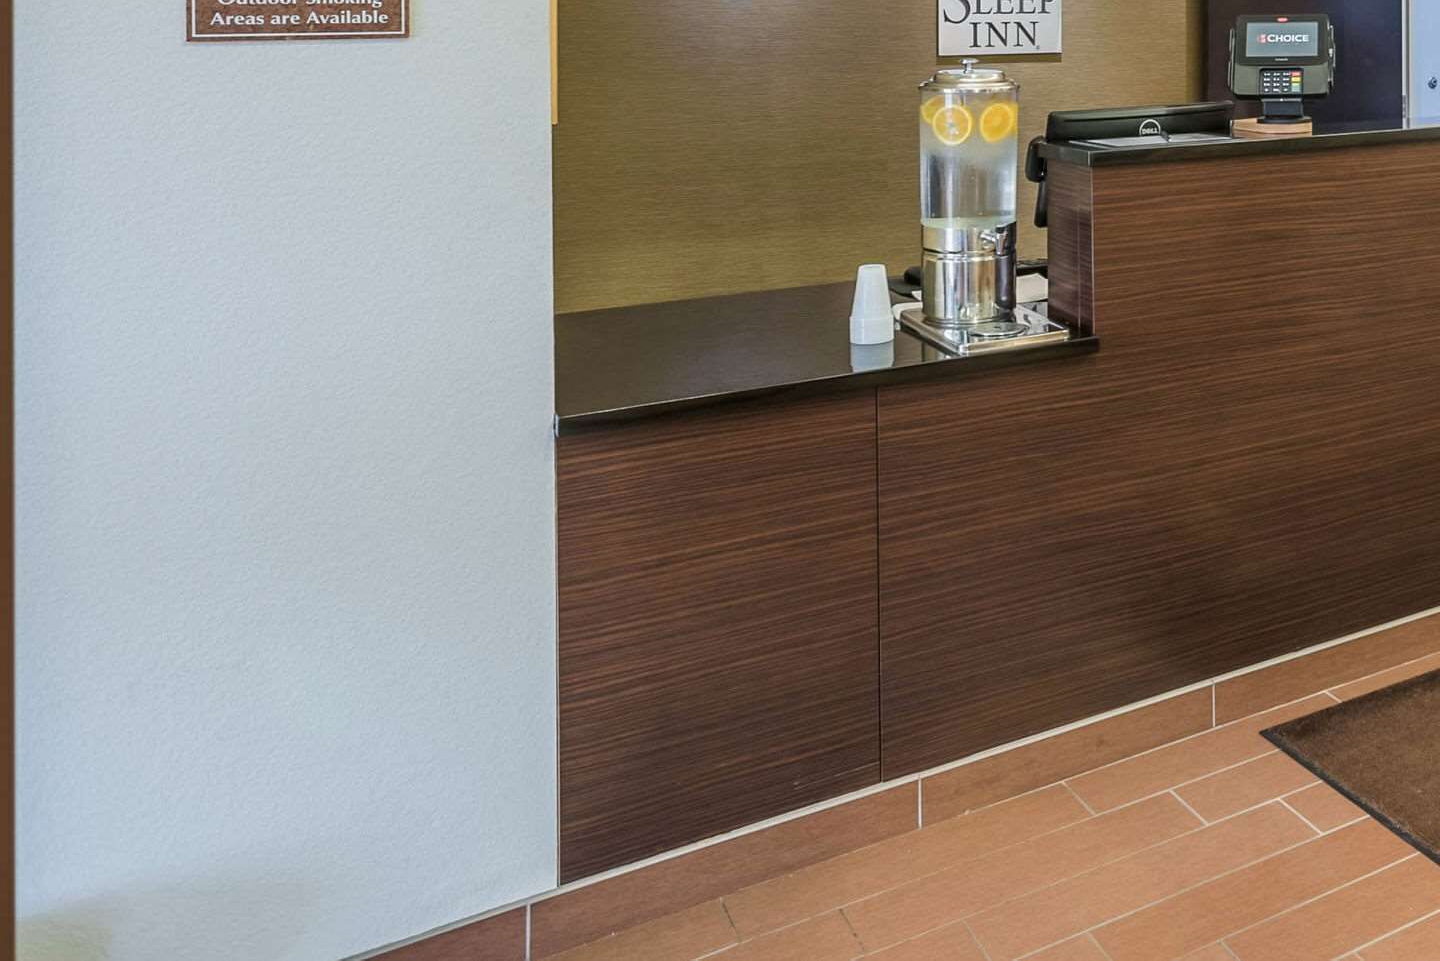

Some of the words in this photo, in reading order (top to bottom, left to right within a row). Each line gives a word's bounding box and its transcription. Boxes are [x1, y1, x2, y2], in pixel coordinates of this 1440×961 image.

[210, 12, 265, 26] Areas
[270, 14, 300, 25] are
[306, 10, 389, 24] Available
[969, 21, 1039, 48] INN
[1267, 34, 1309, 42] CHOICE
